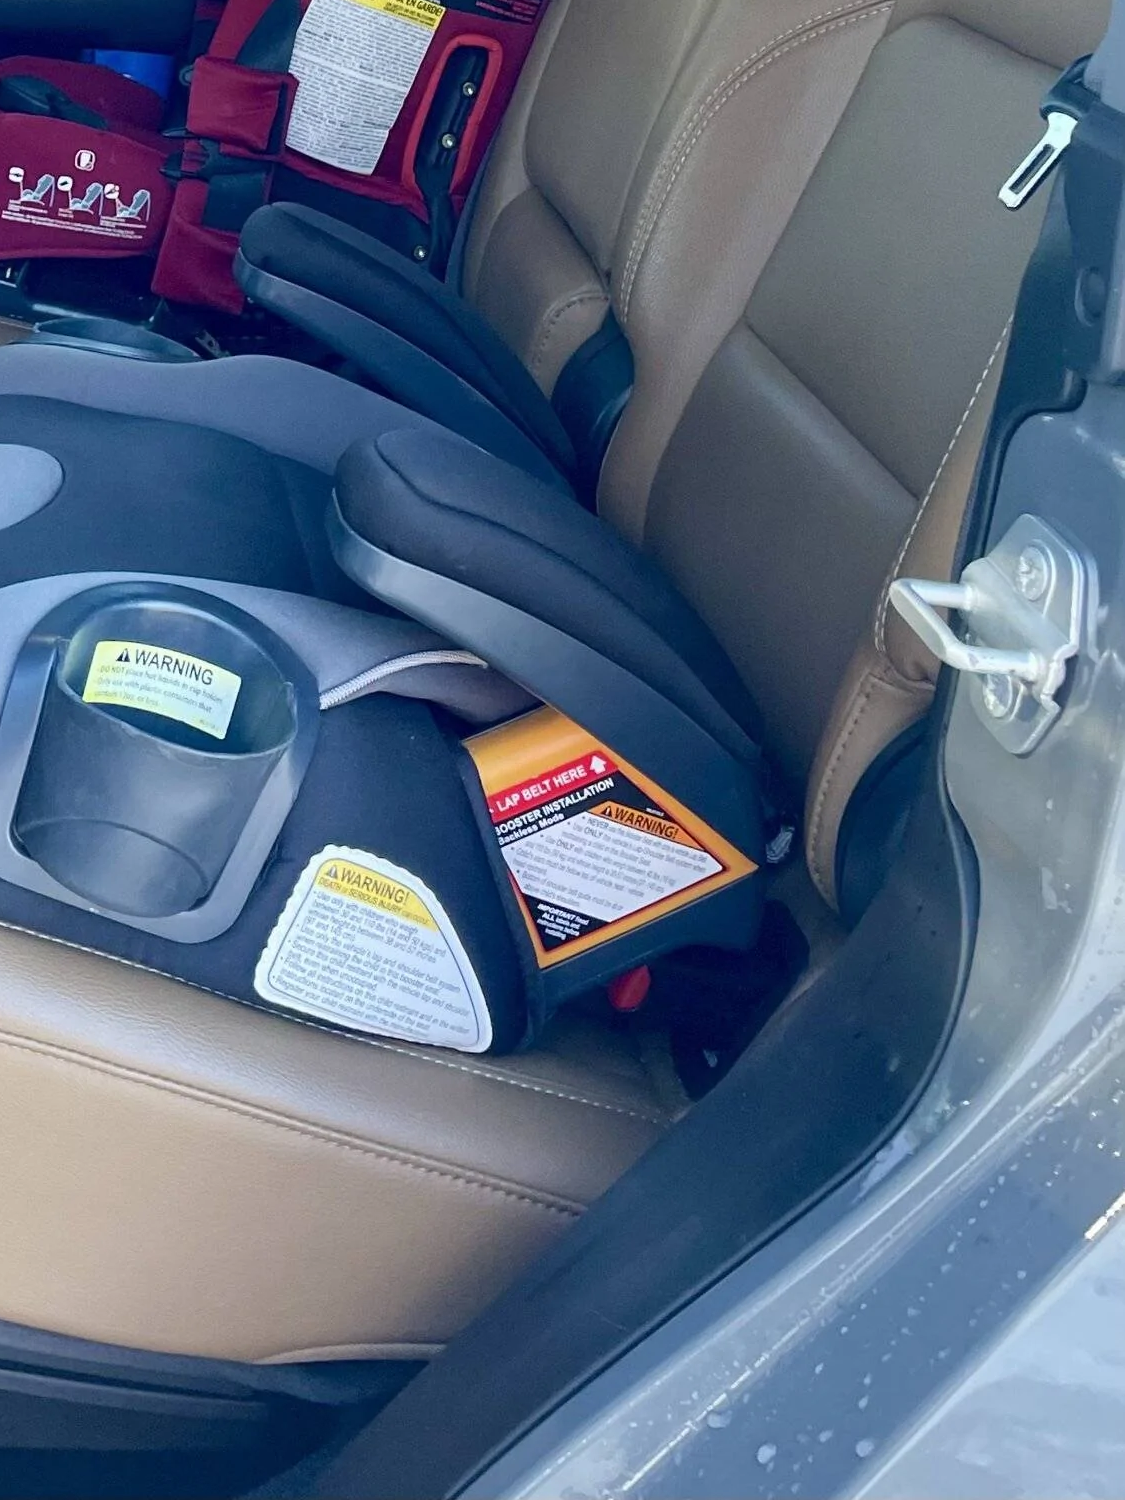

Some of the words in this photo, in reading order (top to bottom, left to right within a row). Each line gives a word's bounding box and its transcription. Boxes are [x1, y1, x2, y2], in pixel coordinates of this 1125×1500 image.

[135, 650, 213, 685] WARNING
[496, 793, 520, 812] LAP
[521, 779, 551, 801] BELT
[552, 765, 587, 787] HERE
[542, 778, 614, 815] INSTALLATION
[538, 813, 564, 828] Mode
[615, 808, 679, 839] WARNING!
[341, 868, 409, 905] WARNING!
[359, 908, 384, 921] children
[541, 912, 554, 922] ALL
